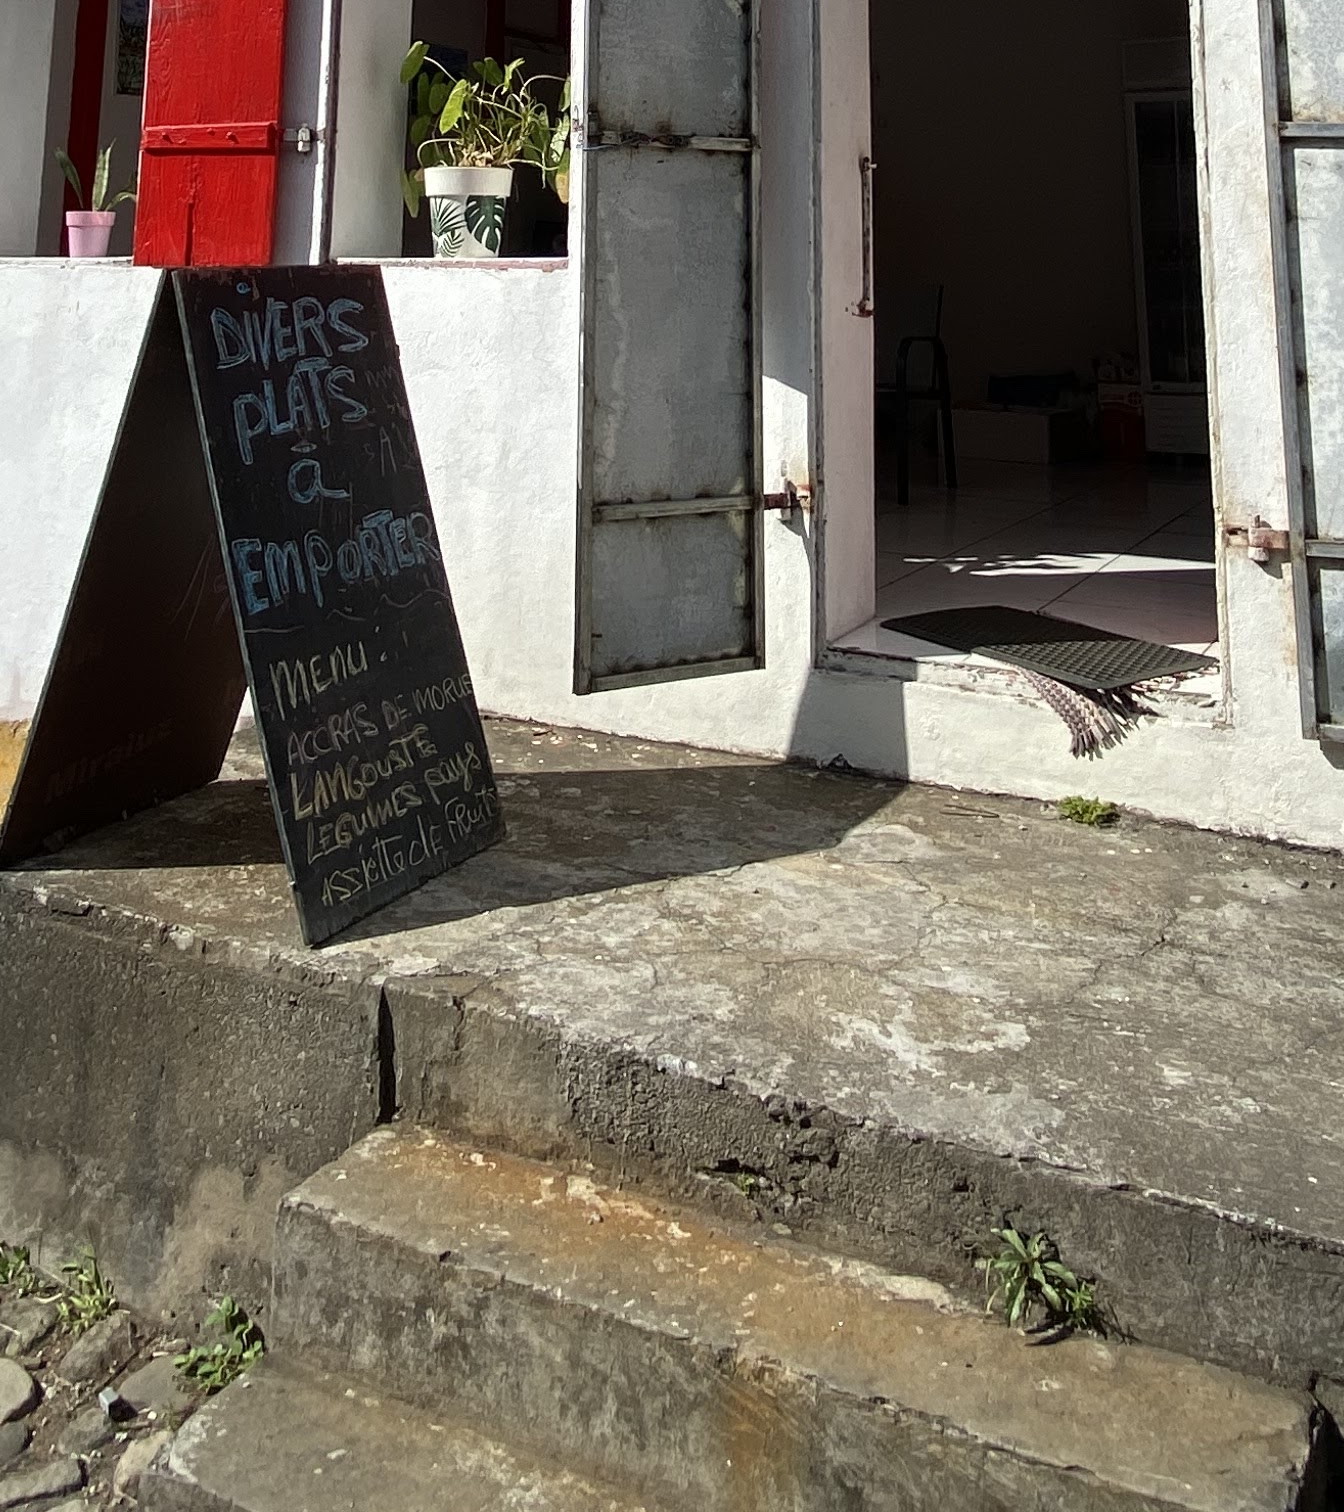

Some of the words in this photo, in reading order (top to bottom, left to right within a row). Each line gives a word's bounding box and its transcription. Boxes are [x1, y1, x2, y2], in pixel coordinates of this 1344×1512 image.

[210, 296, 369, 370] DIVERS
[233, 356, 369, 465] PLATS
[232, 508, 441, 615] EMPORTER
[287, 703, 379, 766] ACCRAS
[381, 694, 410, 730] DE
[412, 672, 473, 715] MORUE
